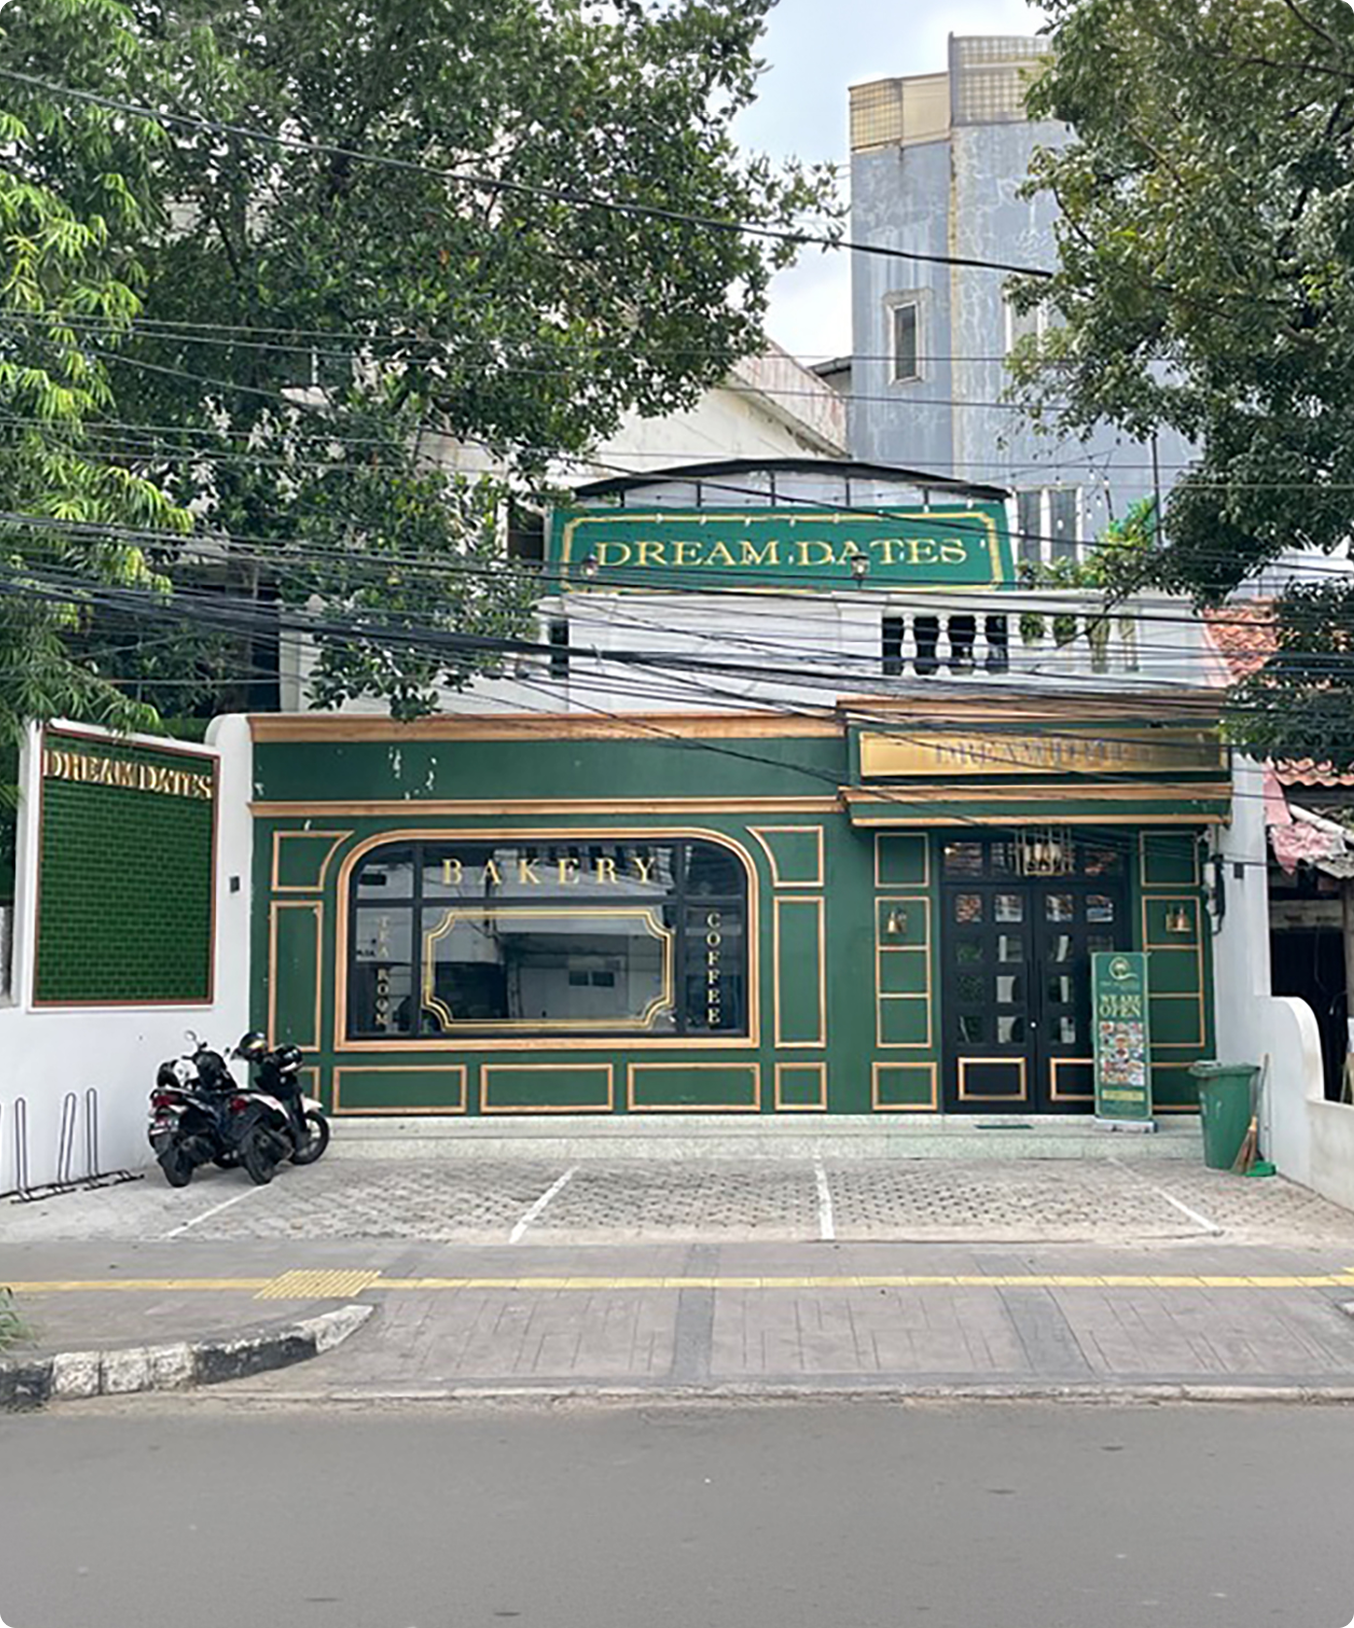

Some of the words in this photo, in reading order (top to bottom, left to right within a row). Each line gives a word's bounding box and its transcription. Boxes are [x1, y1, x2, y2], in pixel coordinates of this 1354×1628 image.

[596, 541, 780, 566] DREAM
[796, 539, 968, 566] DATES
[139, 765, 212, 799] DATES
[442, 857, 655, 884] BAKERY
[706, 912, 721, 1023] COFFEE
